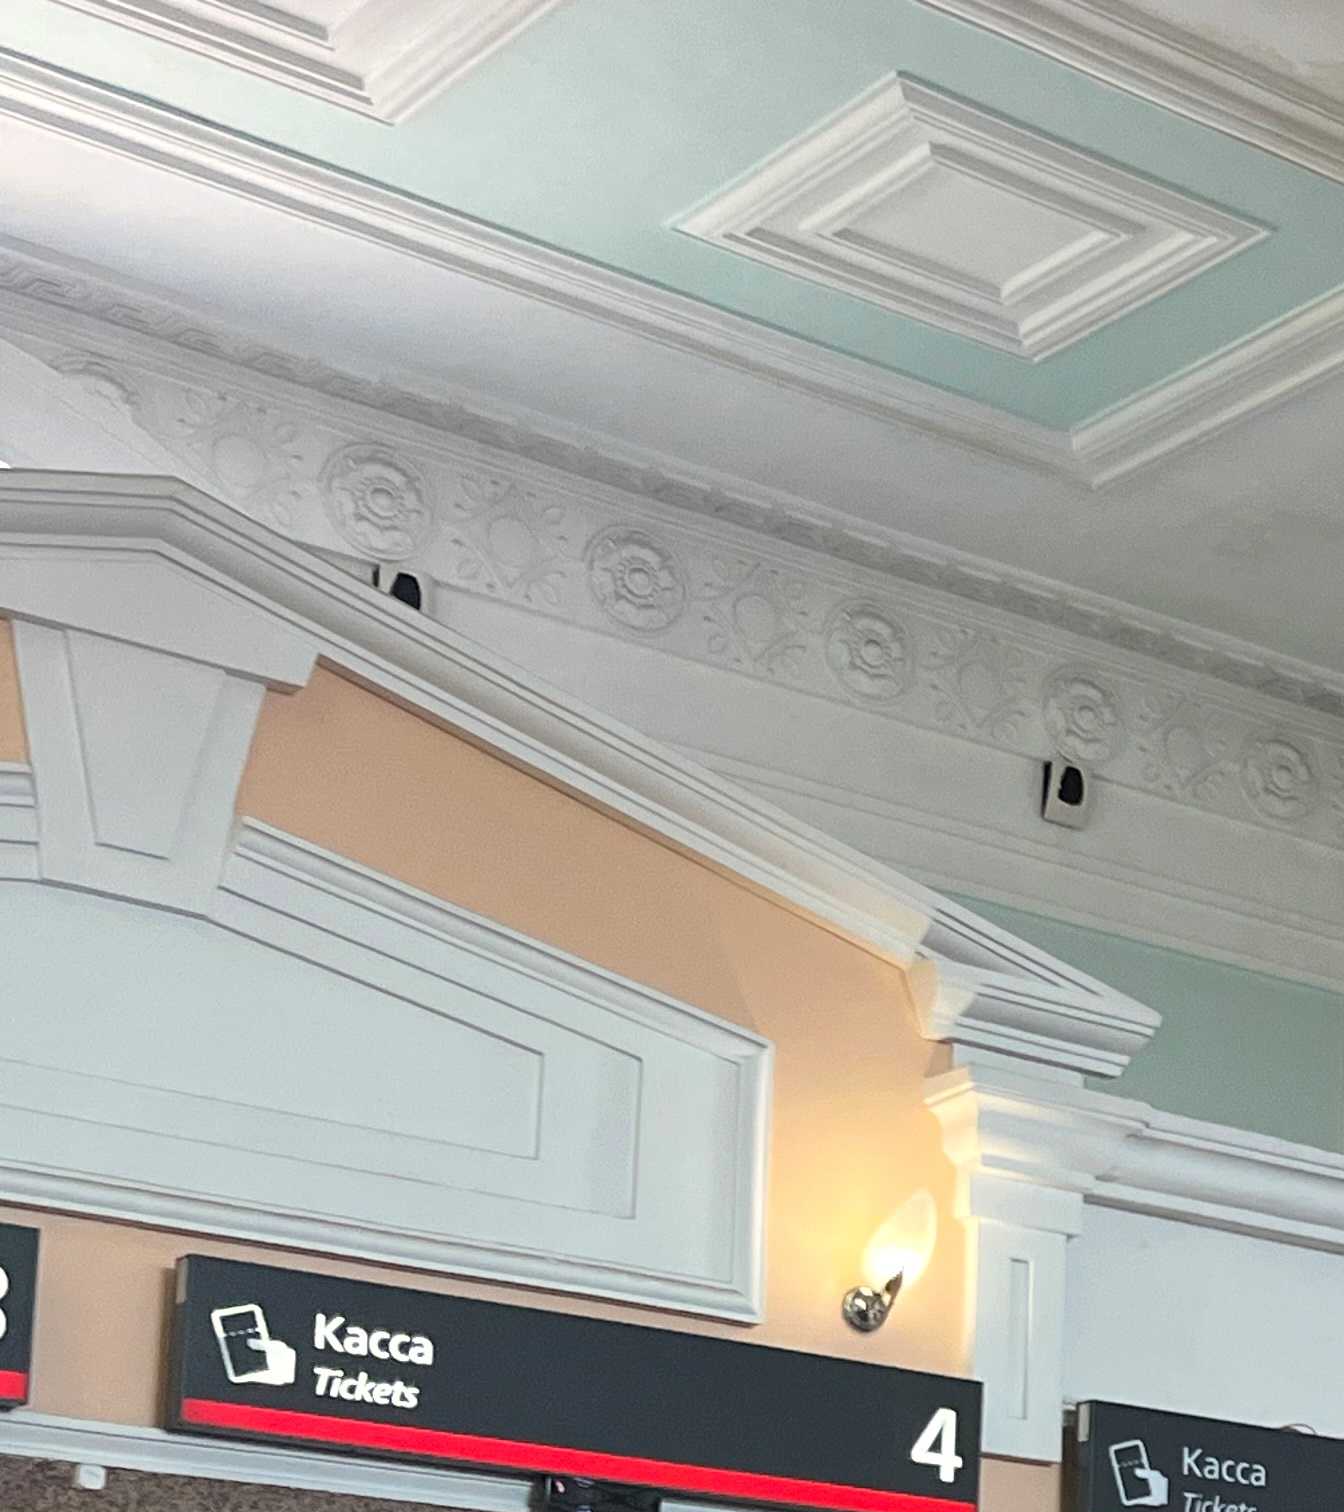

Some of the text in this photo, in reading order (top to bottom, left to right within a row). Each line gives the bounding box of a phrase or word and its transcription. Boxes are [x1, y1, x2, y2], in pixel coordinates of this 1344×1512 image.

[314, 1313, 434, 1367] Касса
[312, 1367, 420, 1409] Tickets
[911, 1407, 963, 1484] 4
[1181, 1446, 1267, 1489] Касса
